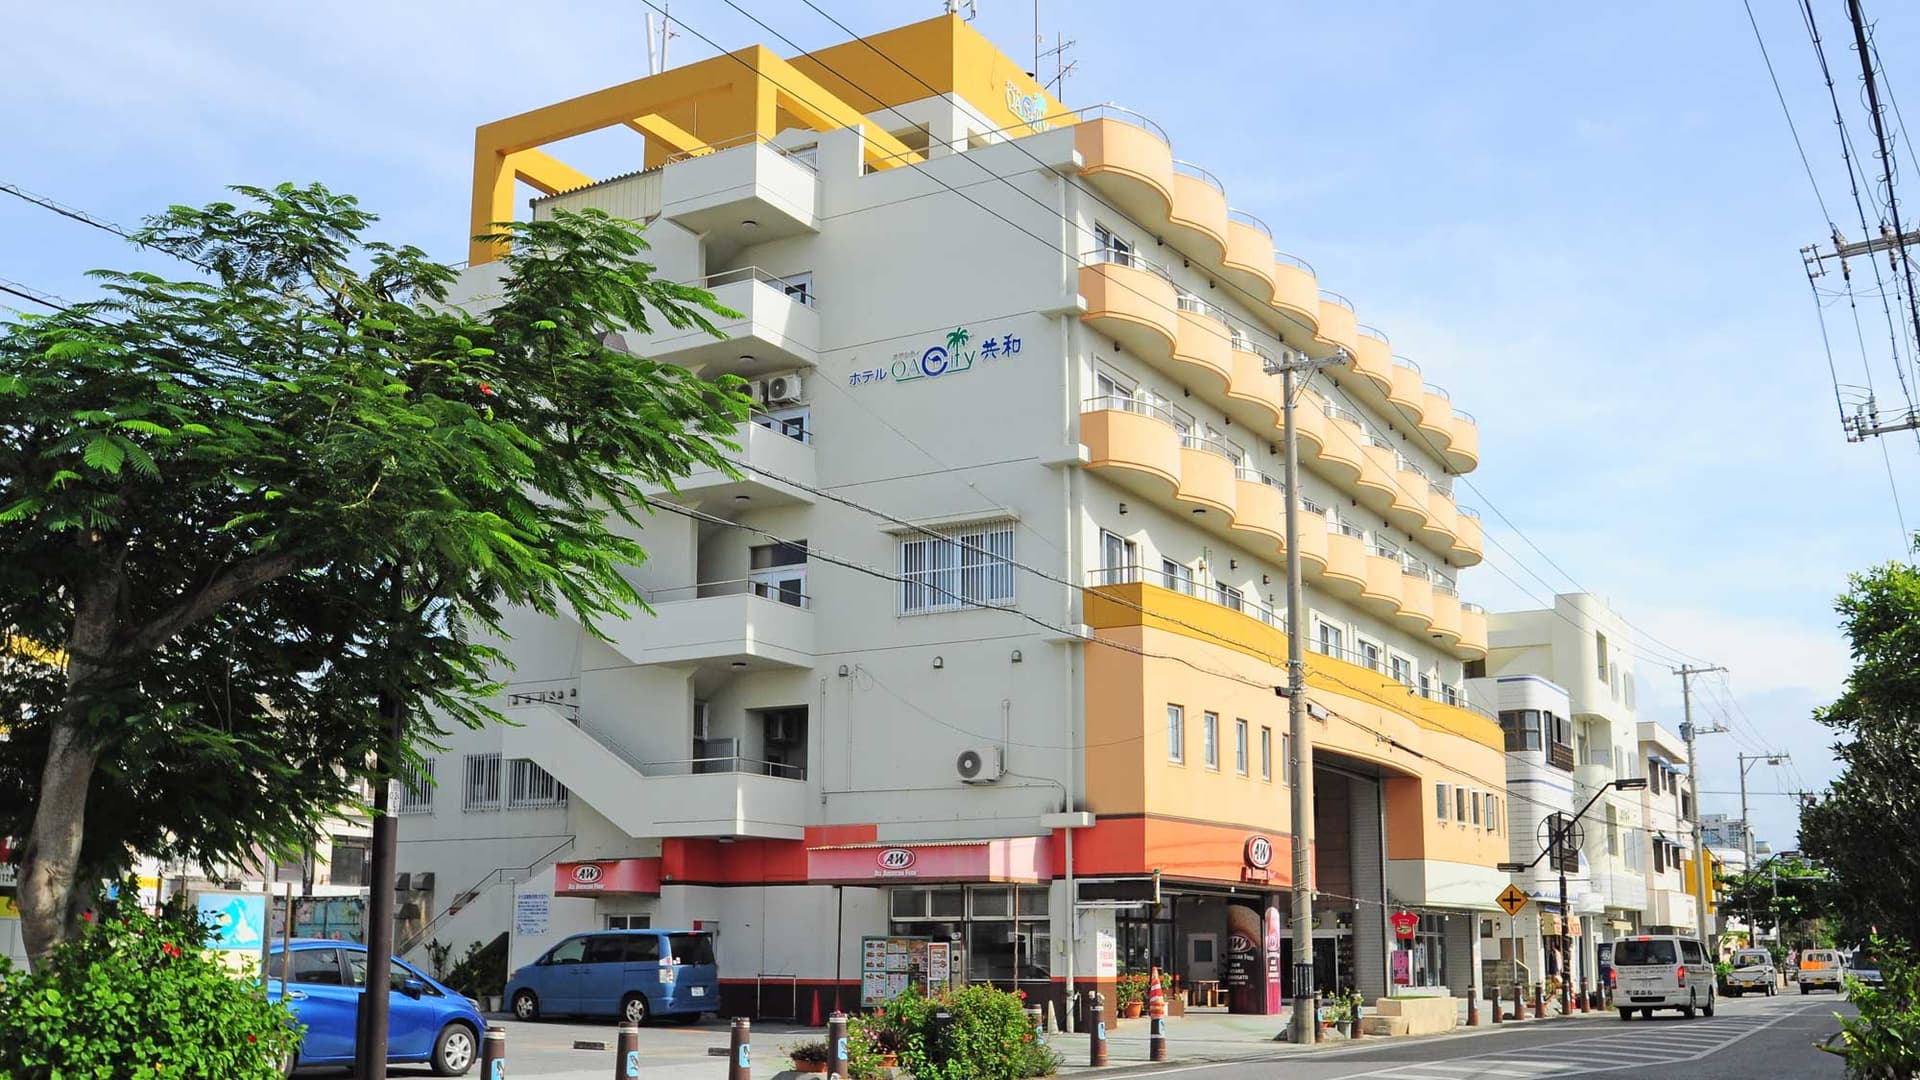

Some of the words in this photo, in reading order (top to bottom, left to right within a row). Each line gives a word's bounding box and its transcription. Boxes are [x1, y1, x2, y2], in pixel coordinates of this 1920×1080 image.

[849, 367, 887, 386] ホテル
[980, 333, 1021, 360] 共和
